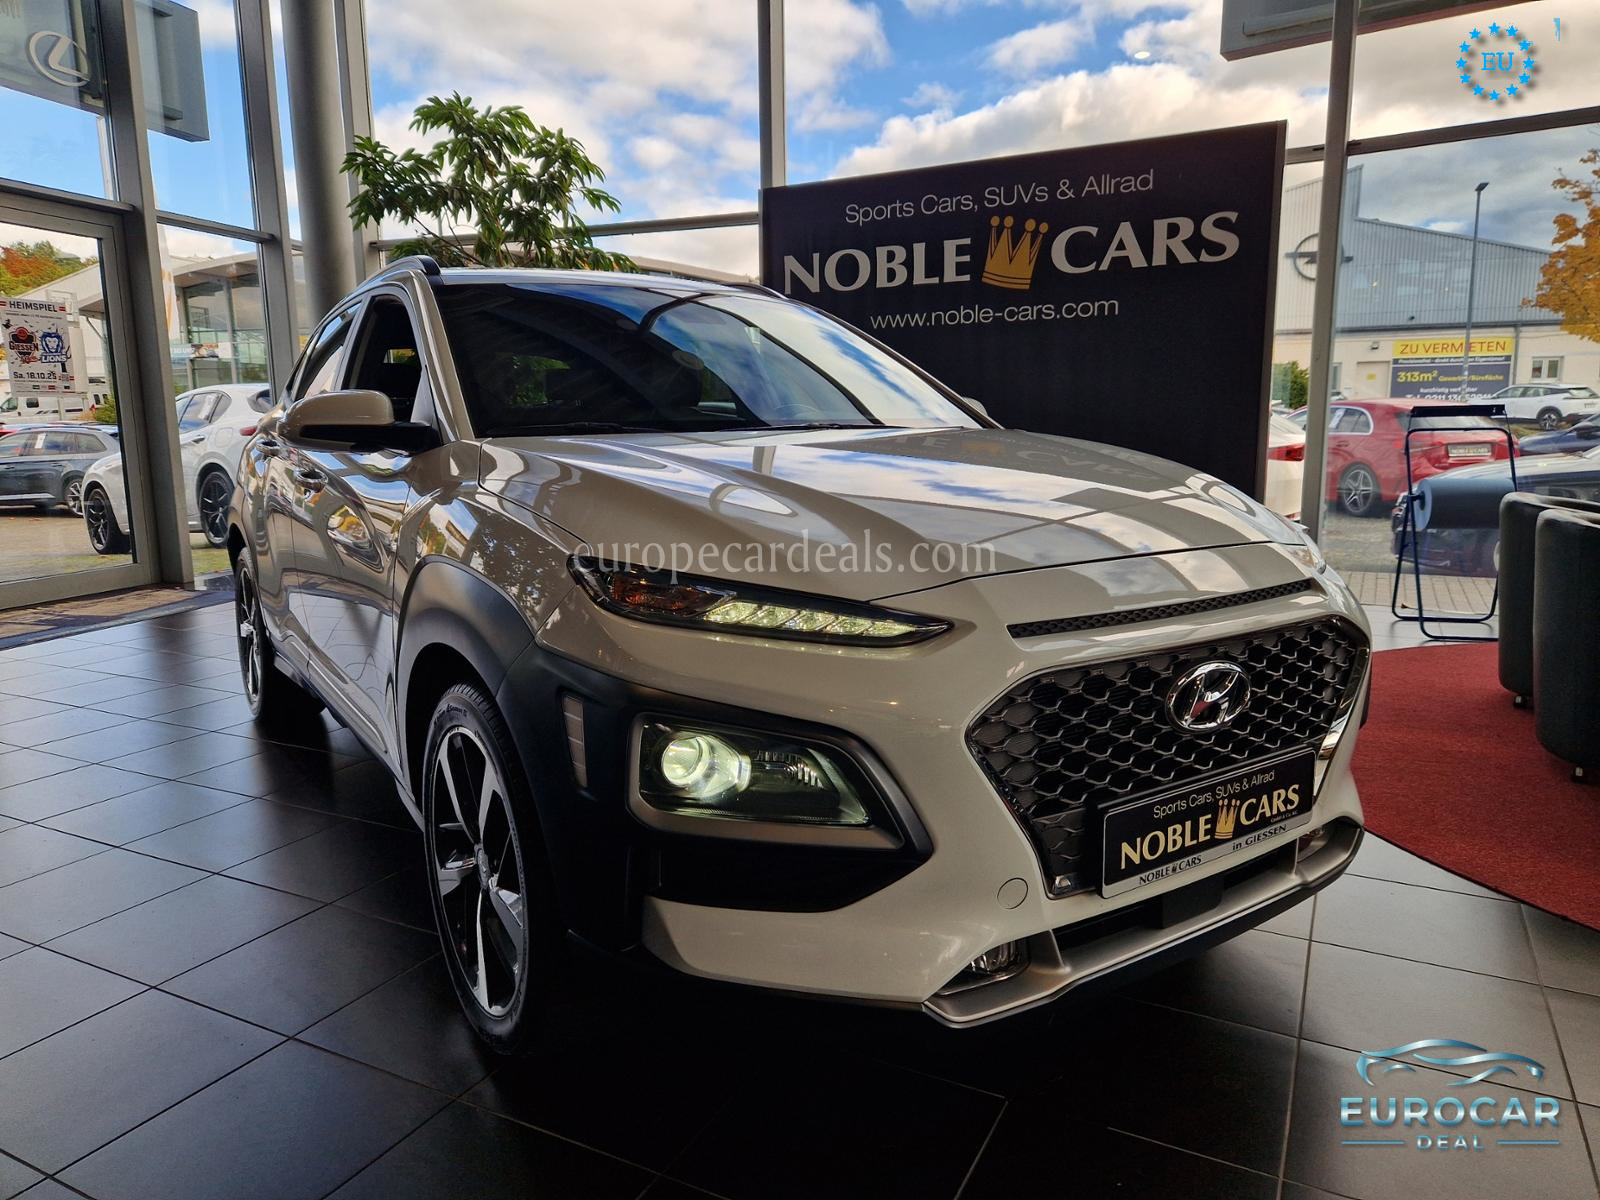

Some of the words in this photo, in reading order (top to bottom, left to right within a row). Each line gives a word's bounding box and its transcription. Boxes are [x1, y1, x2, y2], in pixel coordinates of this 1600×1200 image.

[845, 200, 914, 226] Sports
[920, 193, 978, 213] Cars,
[984, 182, 1049, 208] SUVs
[1056, 179, 1074, 199] &
[1081, 168, 1154, 198] Allrad
[783, 237, 972, 294] NOBLE
[1050, 211, 1240, 274] CARS
[9, 301, 57, 312] HEIMSPIEL
[869, 299, 1119, 330] www.noble-cars.com
[1400, 343, 1419, 355] ZU
[1421, 341, 1507, 354] VERMETEN
[13, 371, 25, 379] Sa.
[27, 372, 57, 380] 18.10.25
[1153, 799, 1187, 819] Sports
[1215, 783, 1241, 800] SUVs
[1242, 777, 1250, 789] &
[1250, 769, 1275, 787] Allrad
[1120, 813, 1213, 870] NOBLE
[1239, 784, 1300, 826] CARS
[1232, 842, 1243, 851] in
[1245, 824, 1288, 846] GIESSEN
[1139, 867, 1171, 885] NOBLE
[1178, 855, 1202, 871] CARS
